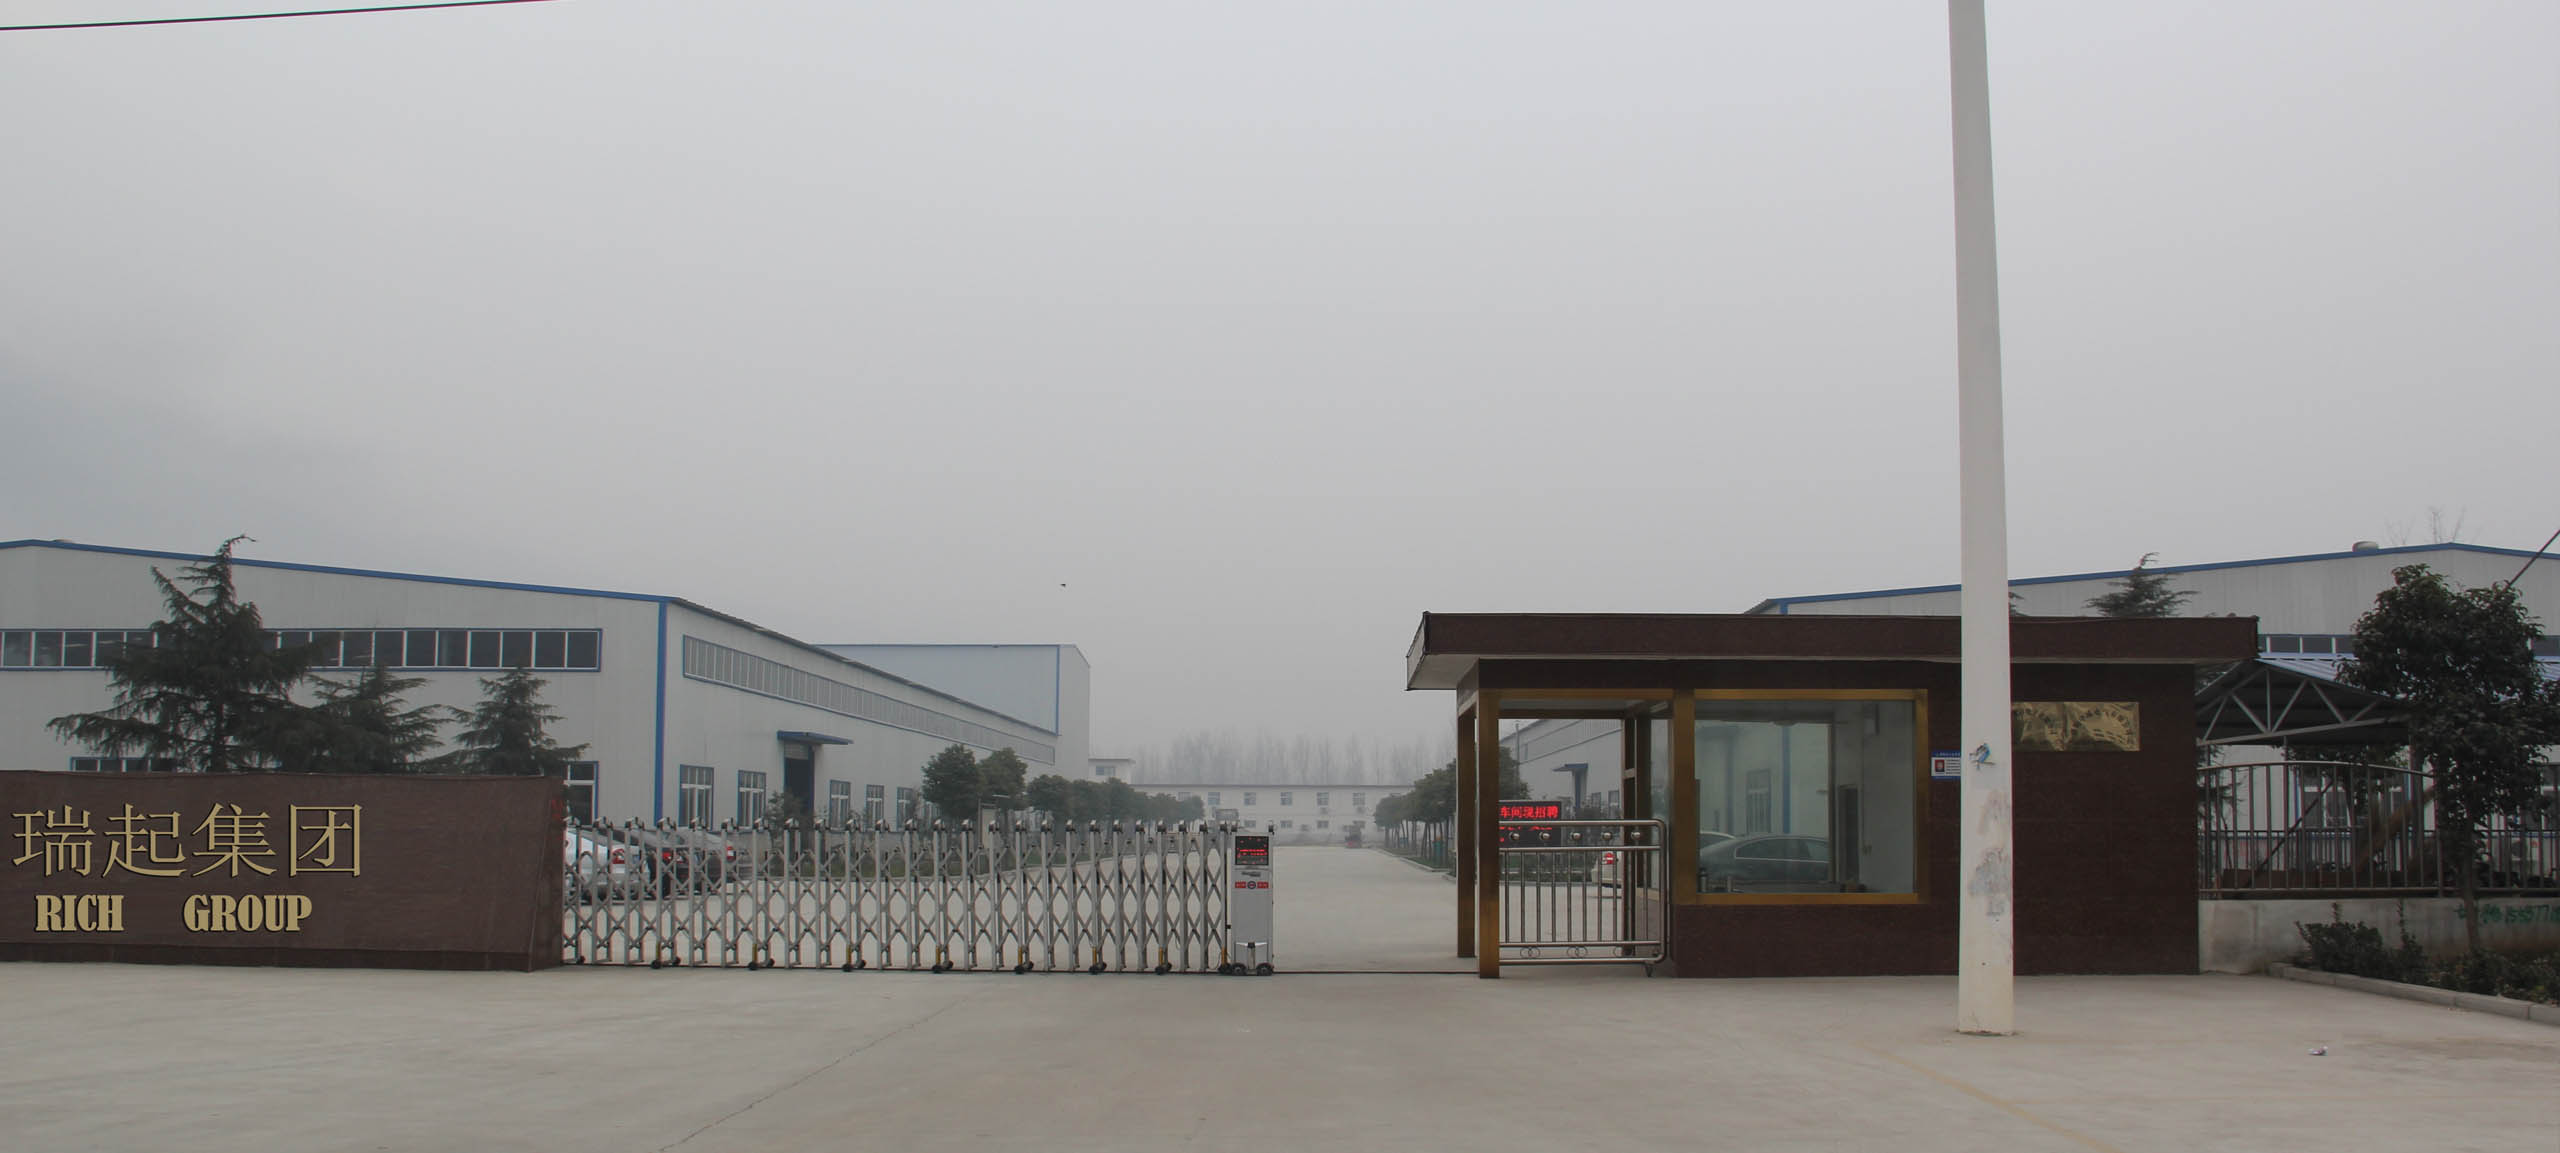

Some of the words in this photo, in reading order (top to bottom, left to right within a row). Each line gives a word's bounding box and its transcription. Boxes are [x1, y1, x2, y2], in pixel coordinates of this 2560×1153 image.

[12, 803, 363, 878] 瑞起集团
[35, 895, 125, 932] RICH
[183, 894, 313, 932] GROUP
